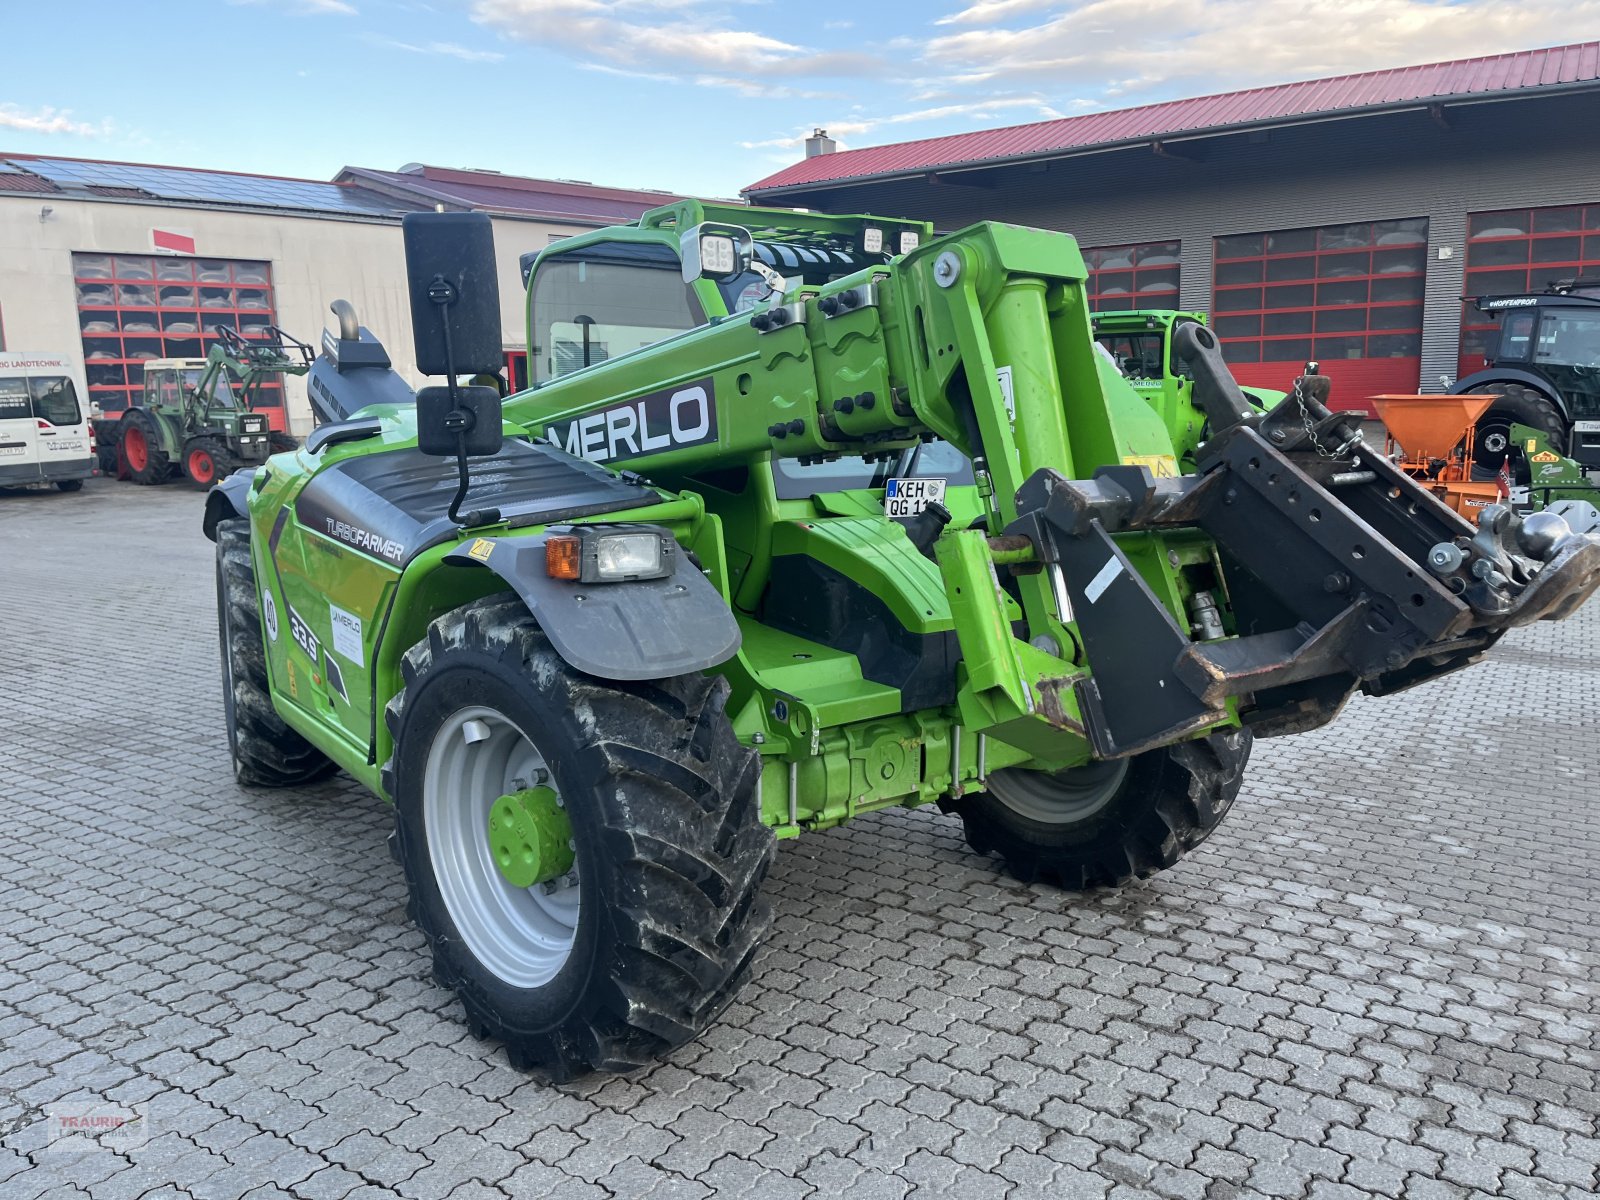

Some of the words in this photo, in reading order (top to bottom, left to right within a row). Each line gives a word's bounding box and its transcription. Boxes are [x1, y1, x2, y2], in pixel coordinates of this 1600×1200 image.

[11, 360, 62, 368] LANDTECHNIK
[548, 386, 710, 462] MERLO
[896, 482, 925, 498] KEH
[890, 500, 908, 516] QG
[326, 517, 404, 561] TURBOFARMER
